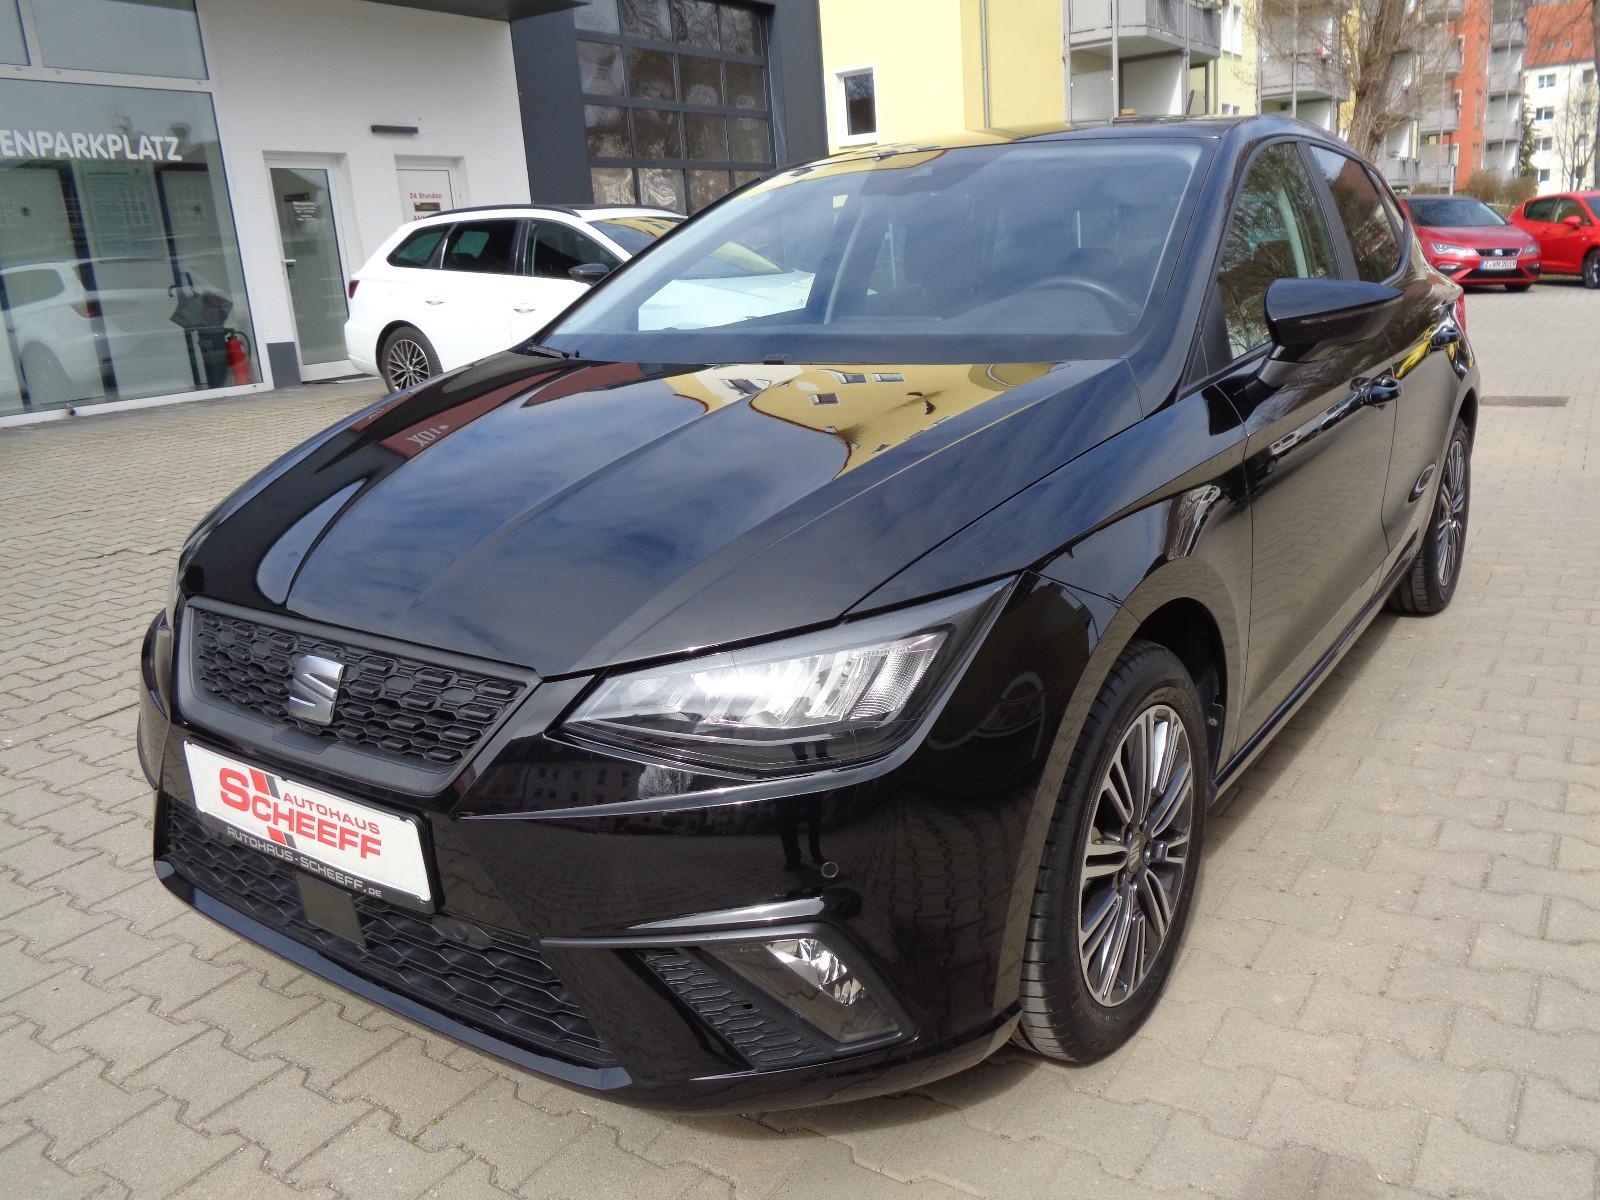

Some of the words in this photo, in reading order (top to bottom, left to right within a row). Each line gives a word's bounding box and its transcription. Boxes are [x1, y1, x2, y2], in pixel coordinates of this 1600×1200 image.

[0, 129, 183, 162] ENPARKPLATZ
[418, 191, 443, 199] Stunden
[219, 767, 382, 859] SCHEEFF
[283, 792, 381, 835] AUTOHAUS
